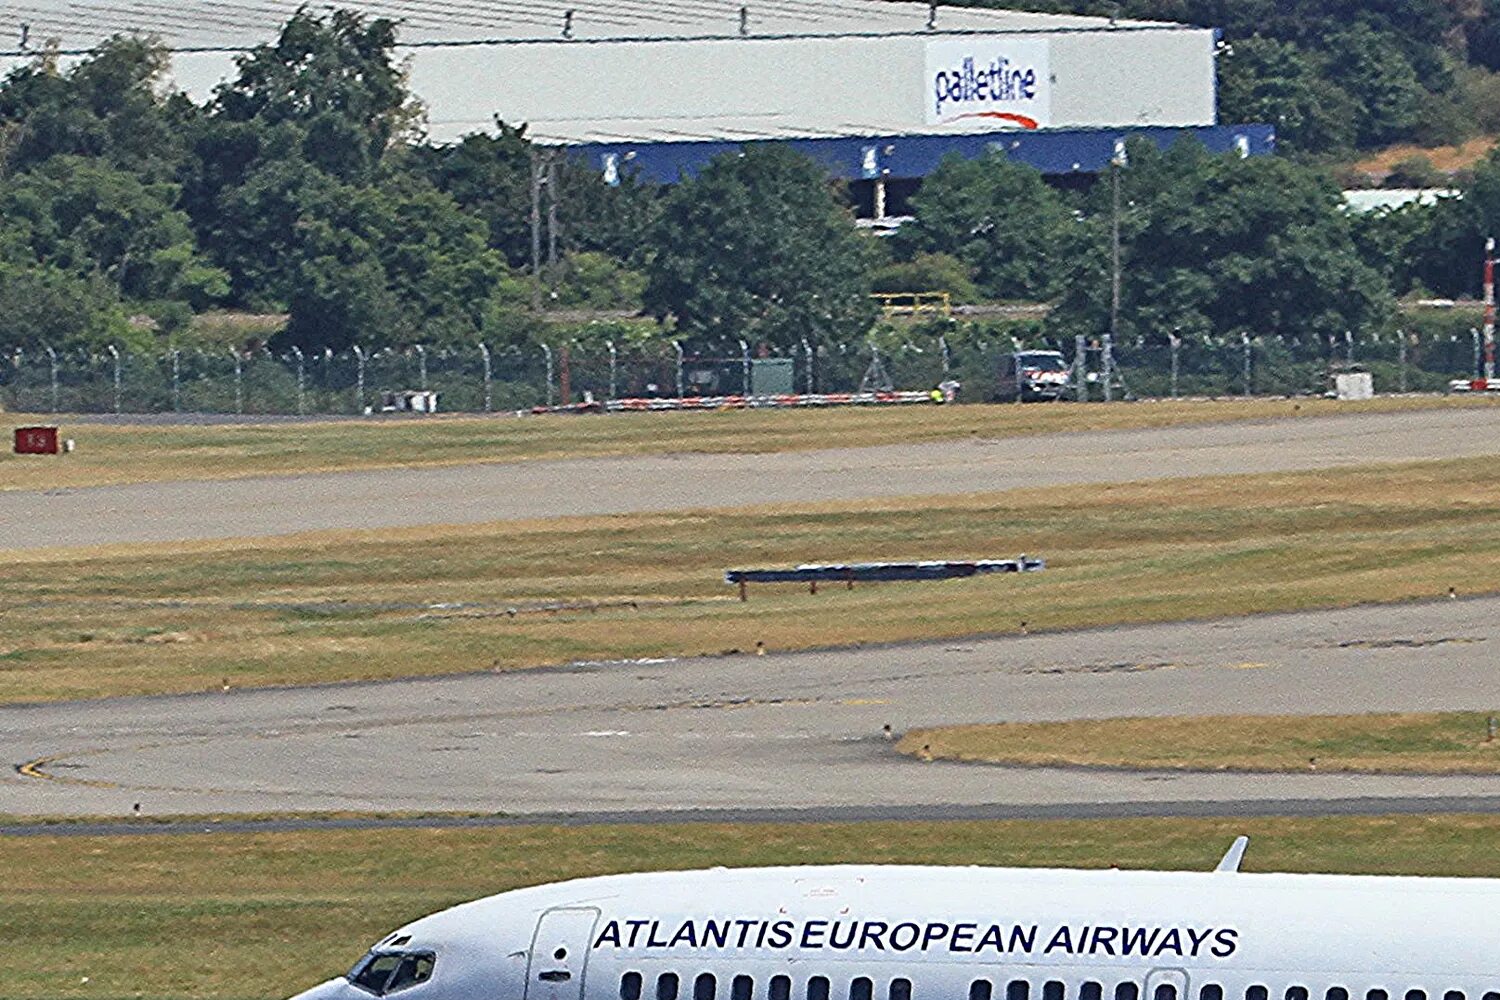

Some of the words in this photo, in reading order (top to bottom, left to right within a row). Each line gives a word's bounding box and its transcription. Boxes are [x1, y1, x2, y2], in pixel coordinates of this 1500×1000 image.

[935, 56, 1036, 115] palletline
[594, 919, 794, 950] ATLANTIS
[800, 920, 1038, 952] EUROPEAN
[1044, 925, 1238, 957] AIRWAYS
